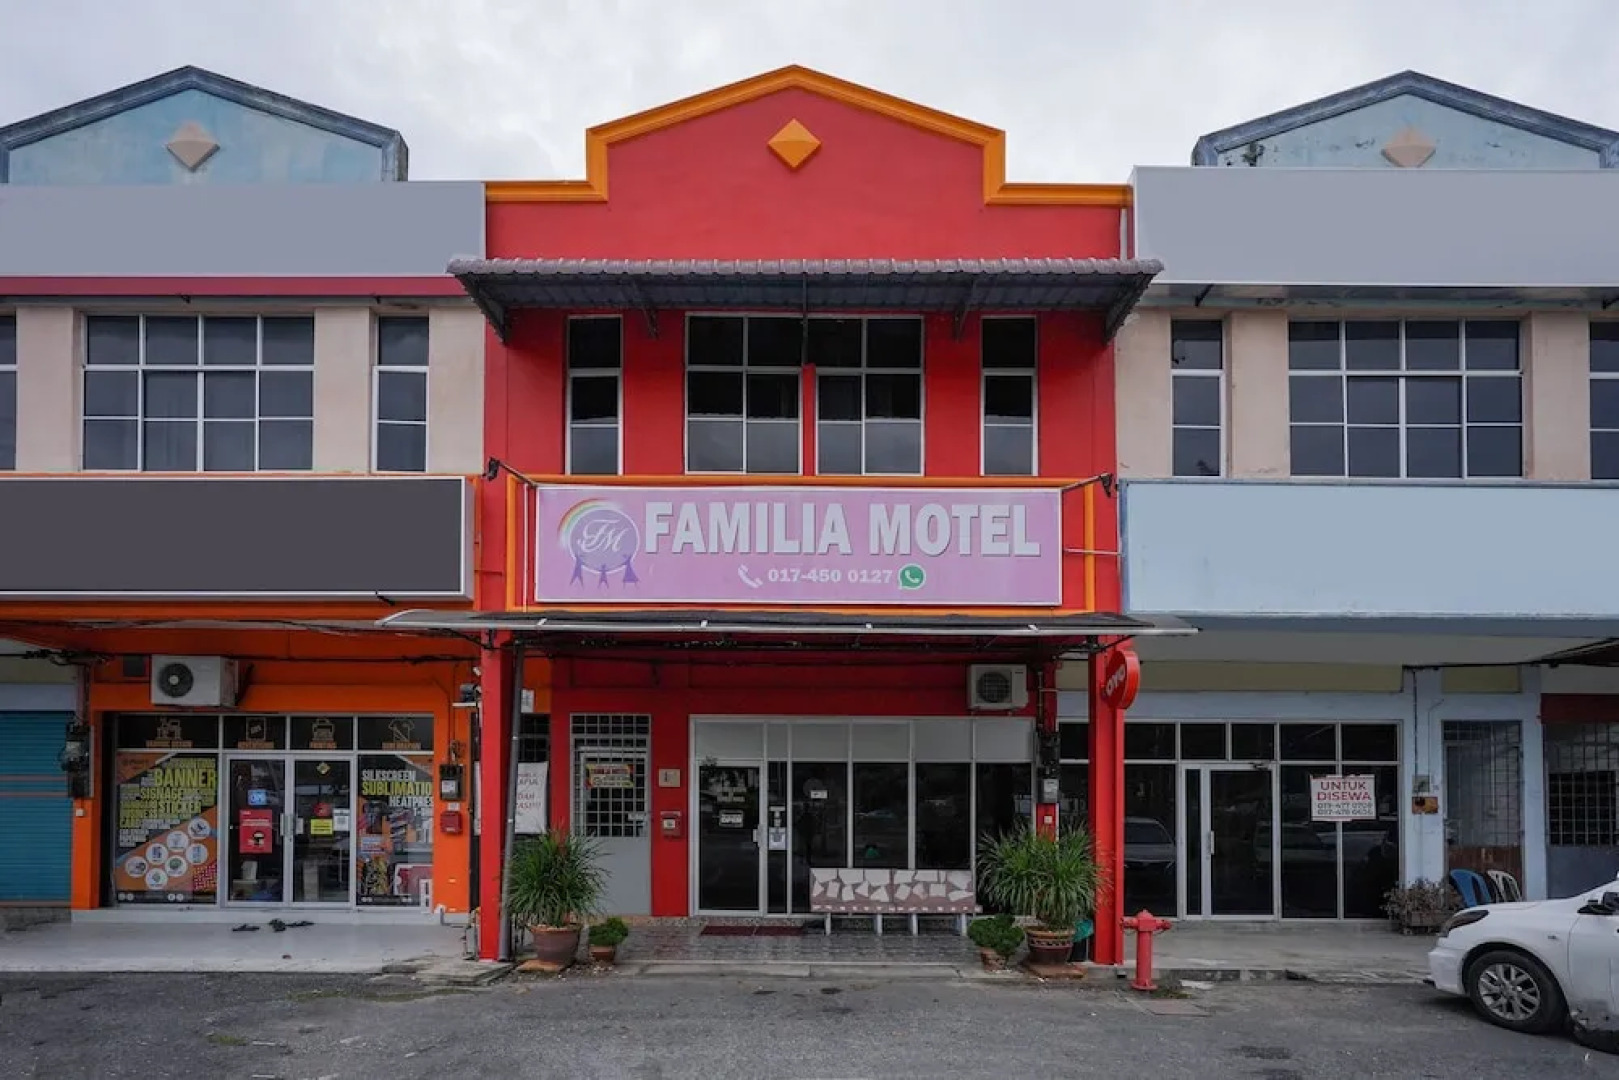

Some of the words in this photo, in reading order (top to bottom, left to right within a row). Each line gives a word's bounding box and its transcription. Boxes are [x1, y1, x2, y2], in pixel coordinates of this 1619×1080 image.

[645, 502, 853, 555] FAMILIA
[868, 503, 1042, 557] MOTEL
[768, 568, 842, 584] 017-450
[847, 569, 893, 584] 0127
[1106, 664, 1126, 697] OYO
[155, 768, 216, 788] BANNER
[362, 769, 417, 782] SILKSCREEN
[1320, 781, 1366, 791] UNTUK
[140, 787, 184, 801] SIGNAGE
[1317, 791, 1372, 801] DISEWA
[158, 800, 202, 814] STICKER
